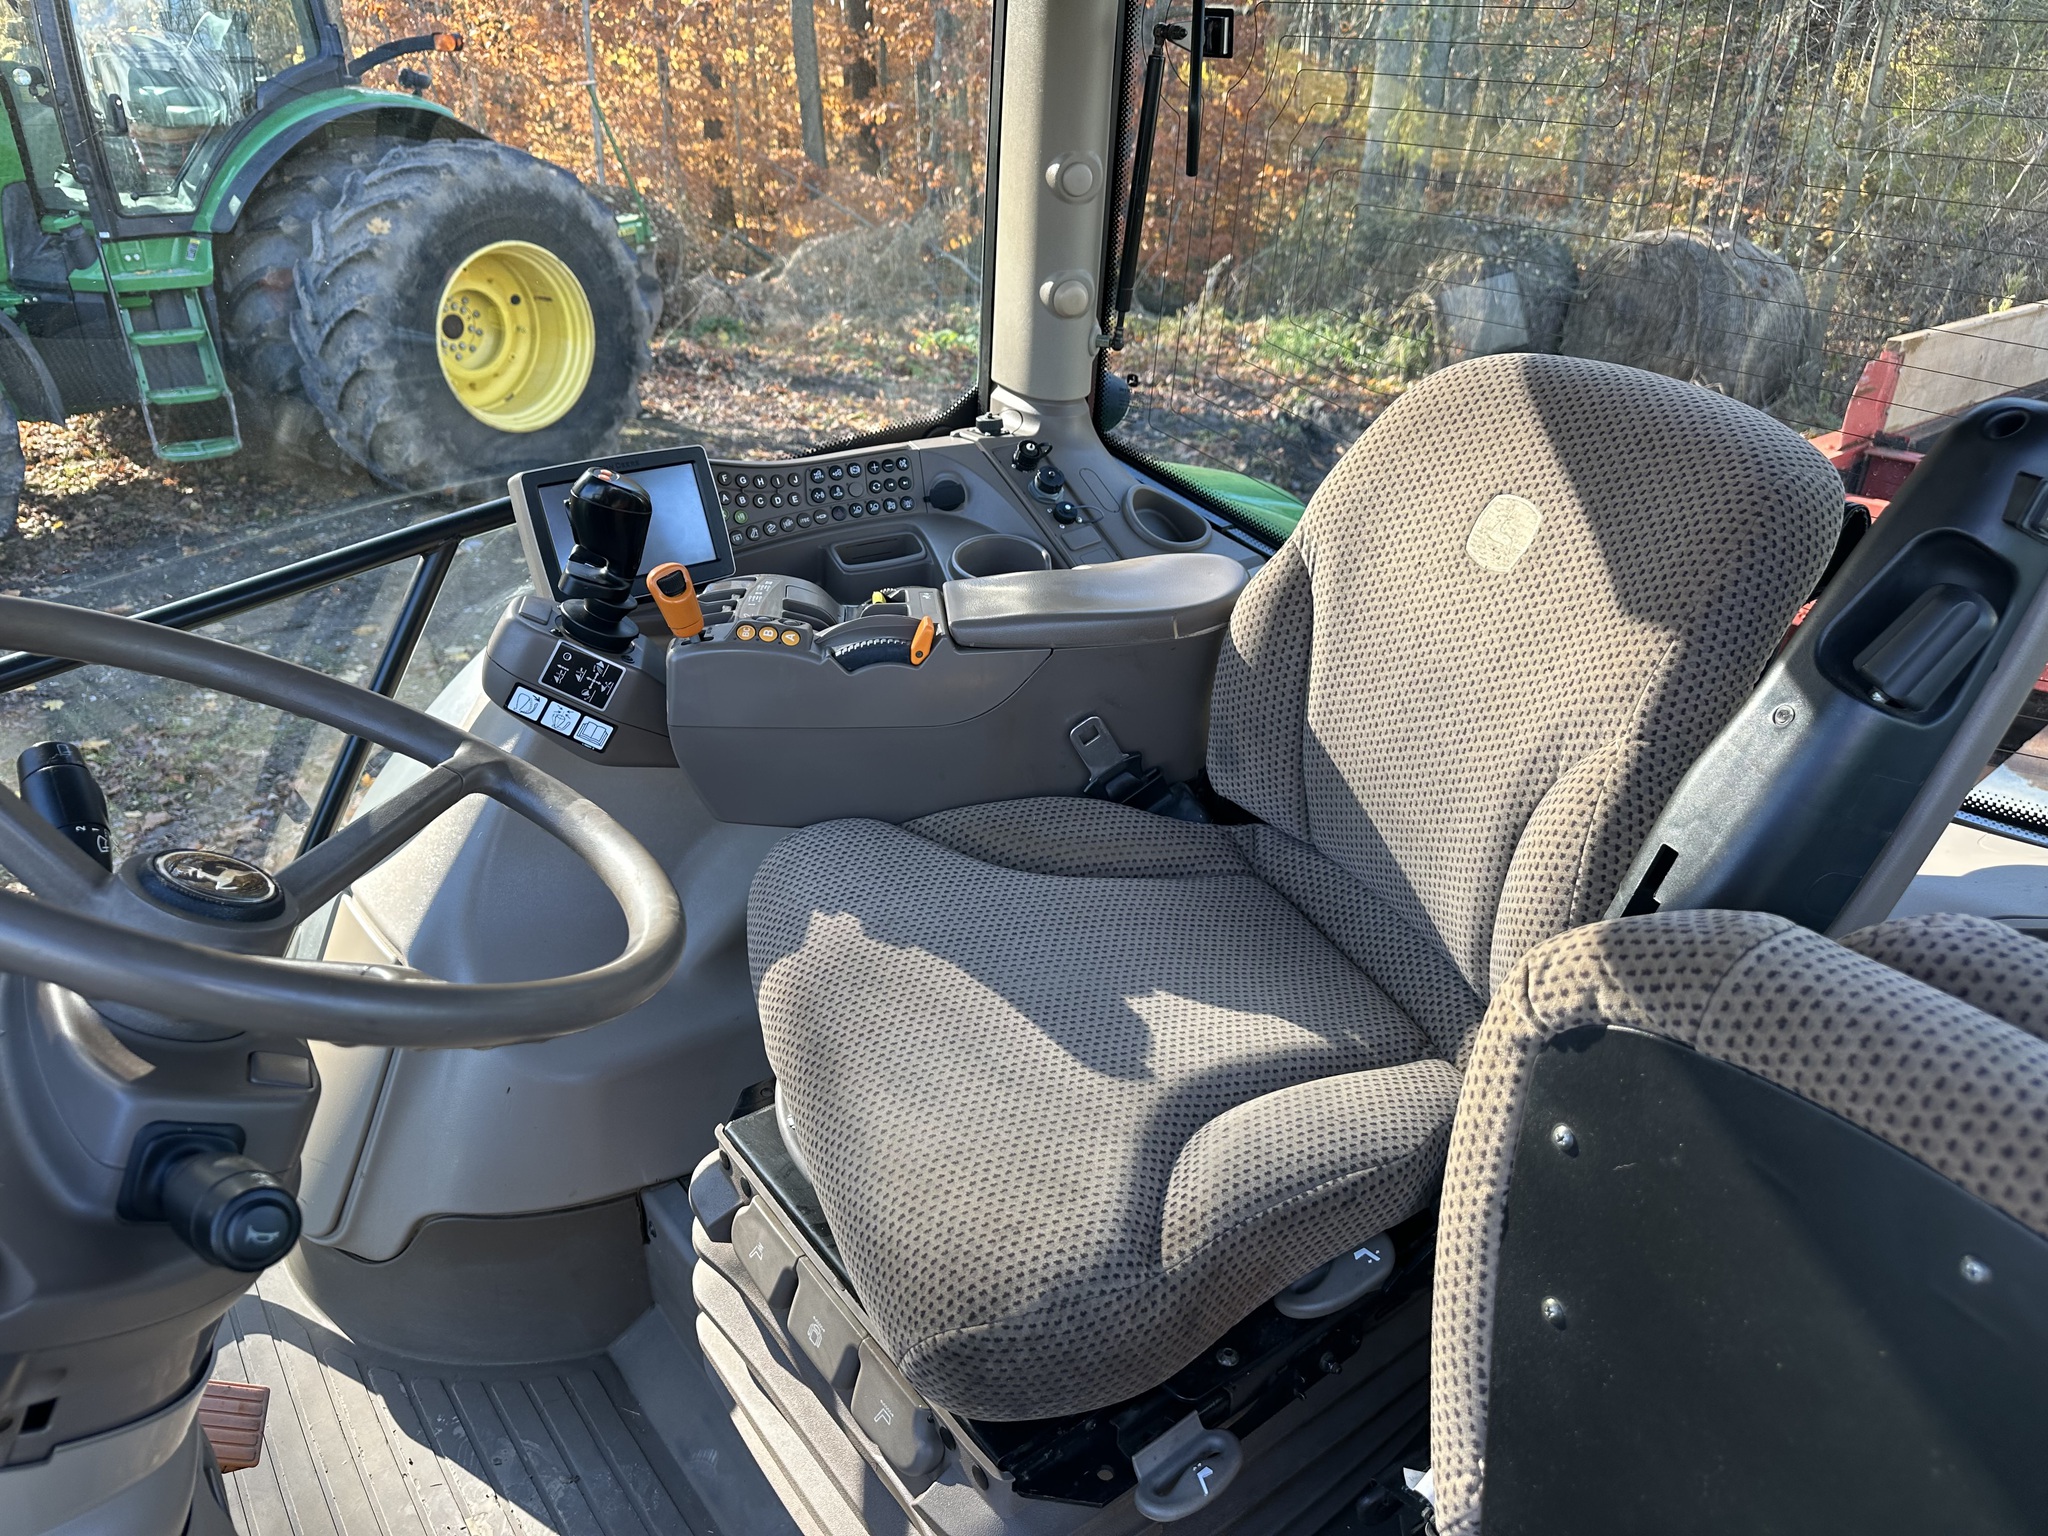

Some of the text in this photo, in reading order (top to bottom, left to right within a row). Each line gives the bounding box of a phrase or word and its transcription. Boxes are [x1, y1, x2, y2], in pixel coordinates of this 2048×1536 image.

[722, 474, 727, 482] F
[793, 475, 798, 483] J
[722, 494, 729, 502] A
[739, 496, 746, 504] B
[792, 495, 799, 503] E
[742, 627, 750, 637] BC
[785, 634, 795, 642] A
